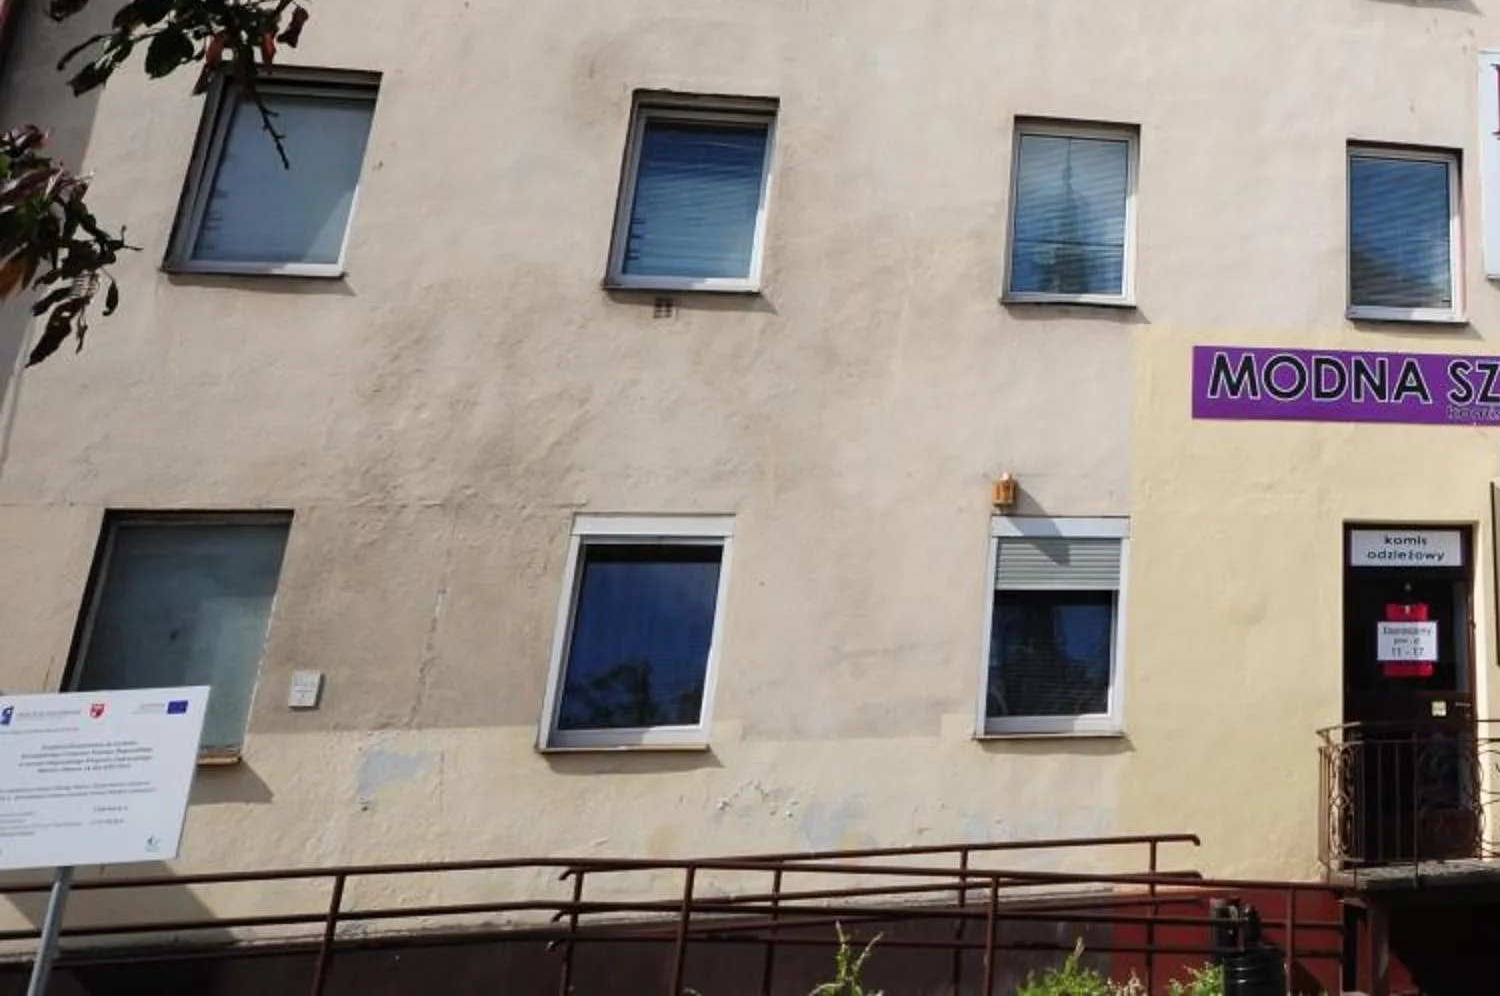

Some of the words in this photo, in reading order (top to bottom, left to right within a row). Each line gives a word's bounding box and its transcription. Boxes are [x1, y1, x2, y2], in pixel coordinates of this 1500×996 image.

[1207, 352, 1433, 404] MODNA
[1384, 533, 1428, 546] komis
[1367, 548, 1445, 562] odzieżowy
